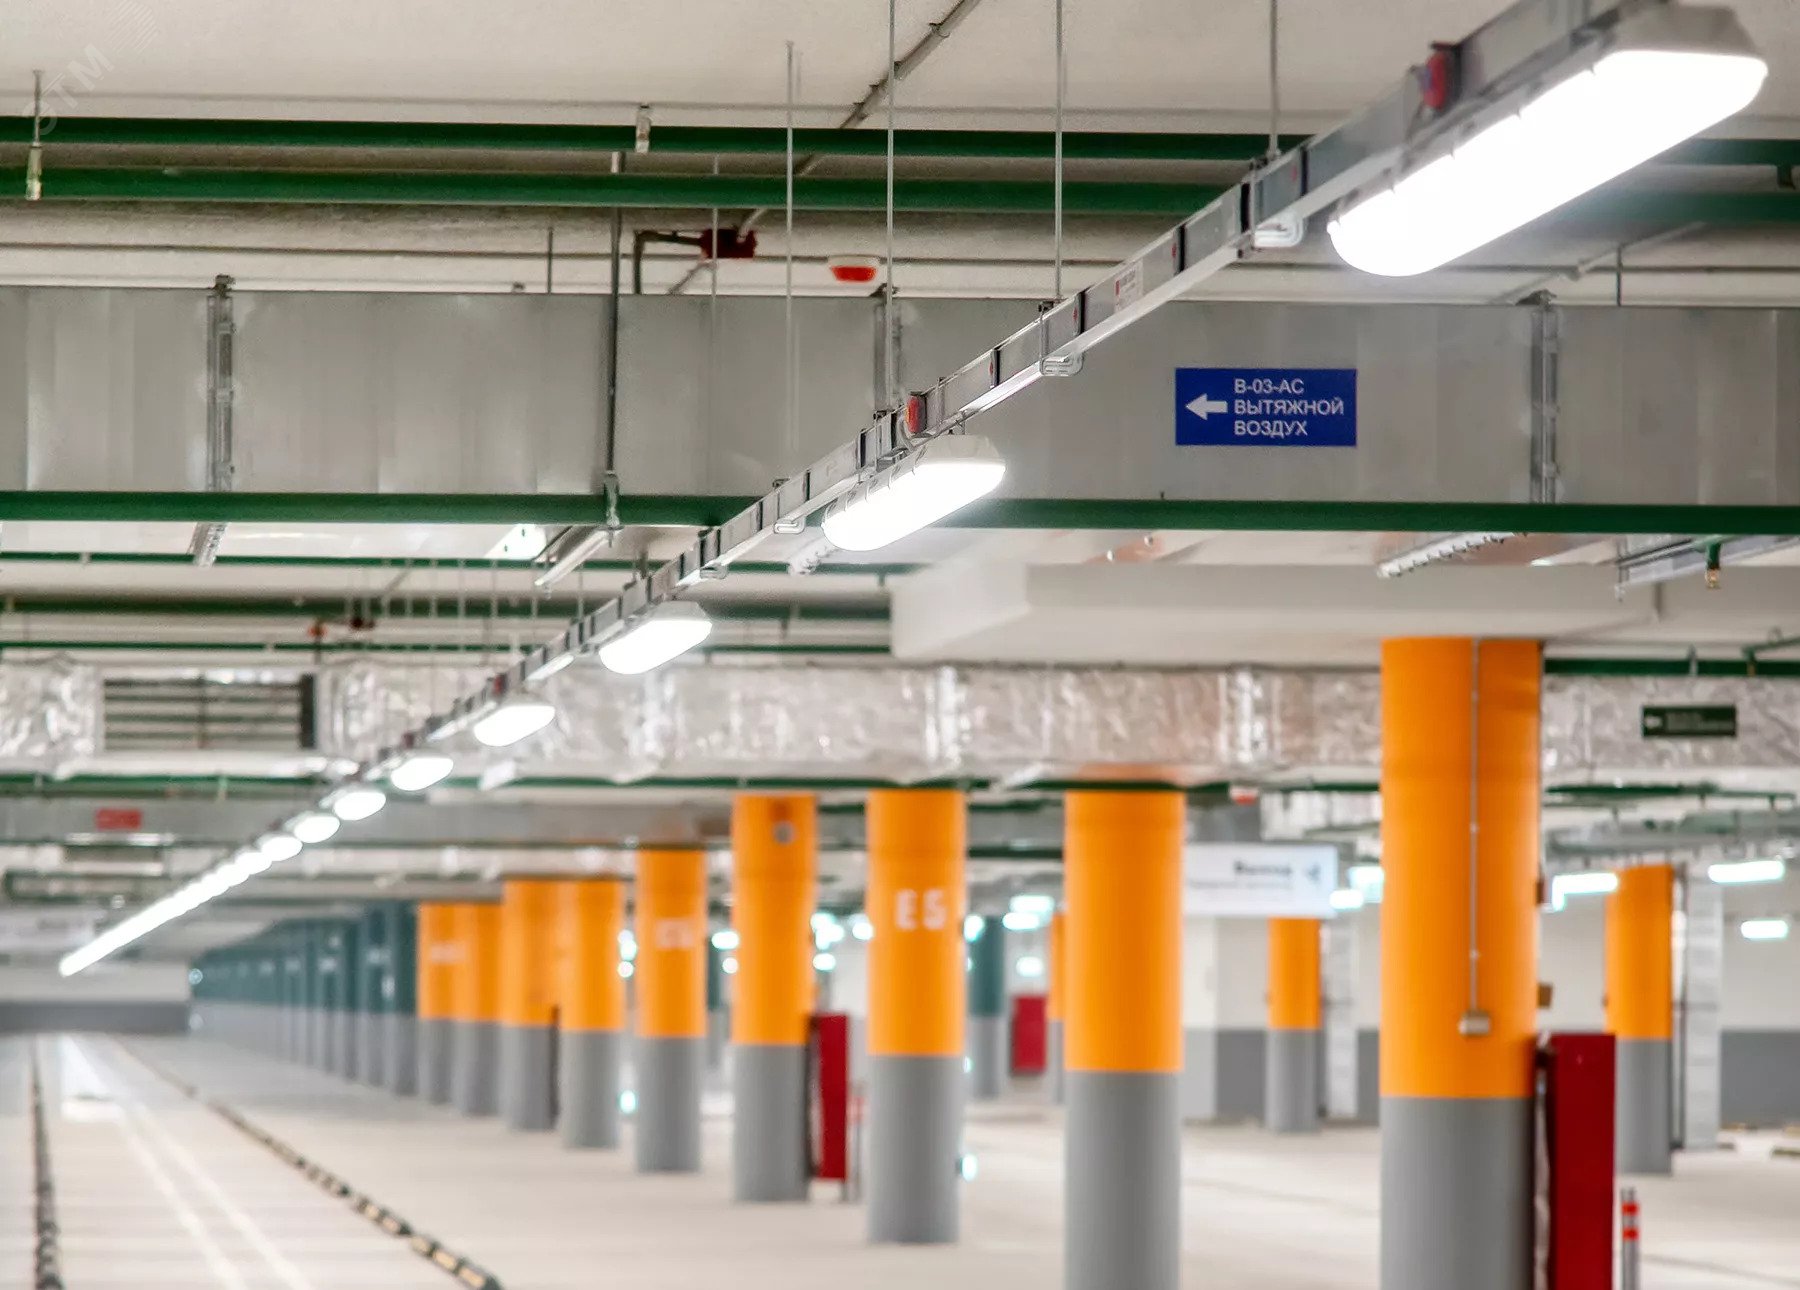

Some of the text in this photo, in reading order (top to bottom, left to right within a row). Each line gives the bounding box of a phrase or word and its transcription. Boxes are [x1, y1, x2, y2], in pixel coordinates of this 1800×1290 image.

[1234, 378, 1304, 394] В-03-АС
[1234, 397, 1344, 415] ВЫТЯЖНОЙ
[1234, 420, 1308, 438] ВОЗДУХ
